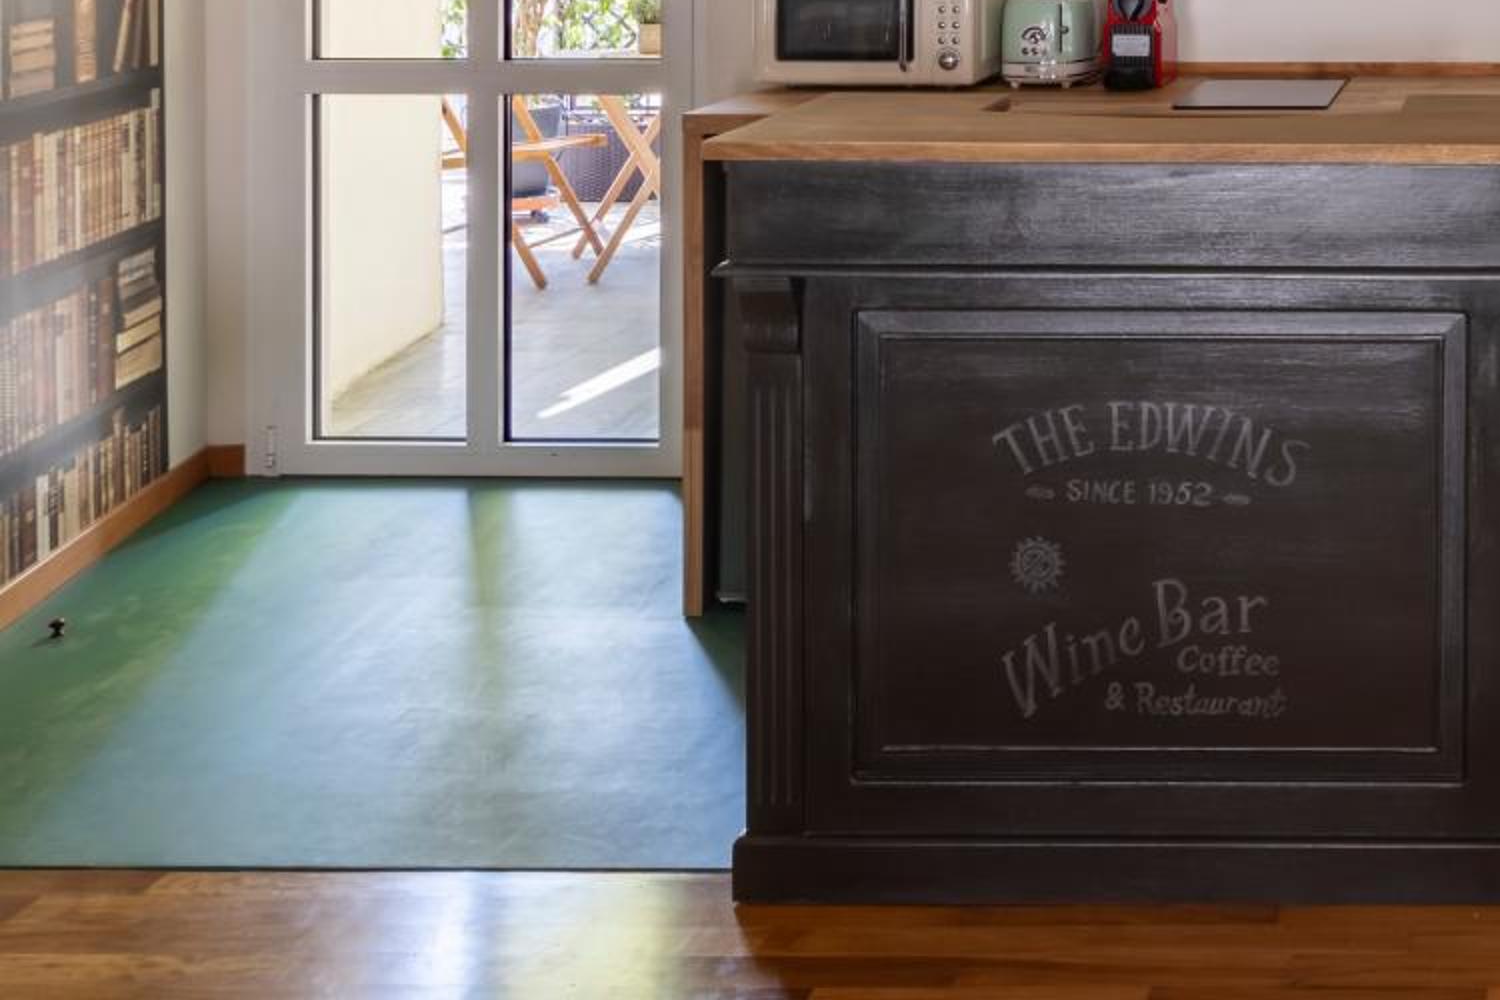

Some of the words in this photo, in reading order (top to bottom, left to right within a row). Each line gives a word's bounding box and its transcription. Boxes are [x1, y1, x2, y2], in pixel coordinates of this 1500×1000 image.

[992, 404, 1094, 474] THE
[1105, 400, 1311, 486] EDWINS
[1066, 479, 1136, 505] SINCE
[1002, 616, 1145, 718] Wine
[1152, 578, 1269, 649] Bar
[1177, 645, 1280, 676] Coffee
[1104, 682, 1126, 711] &
[1134, 682, 1287, 718] Restaurant
